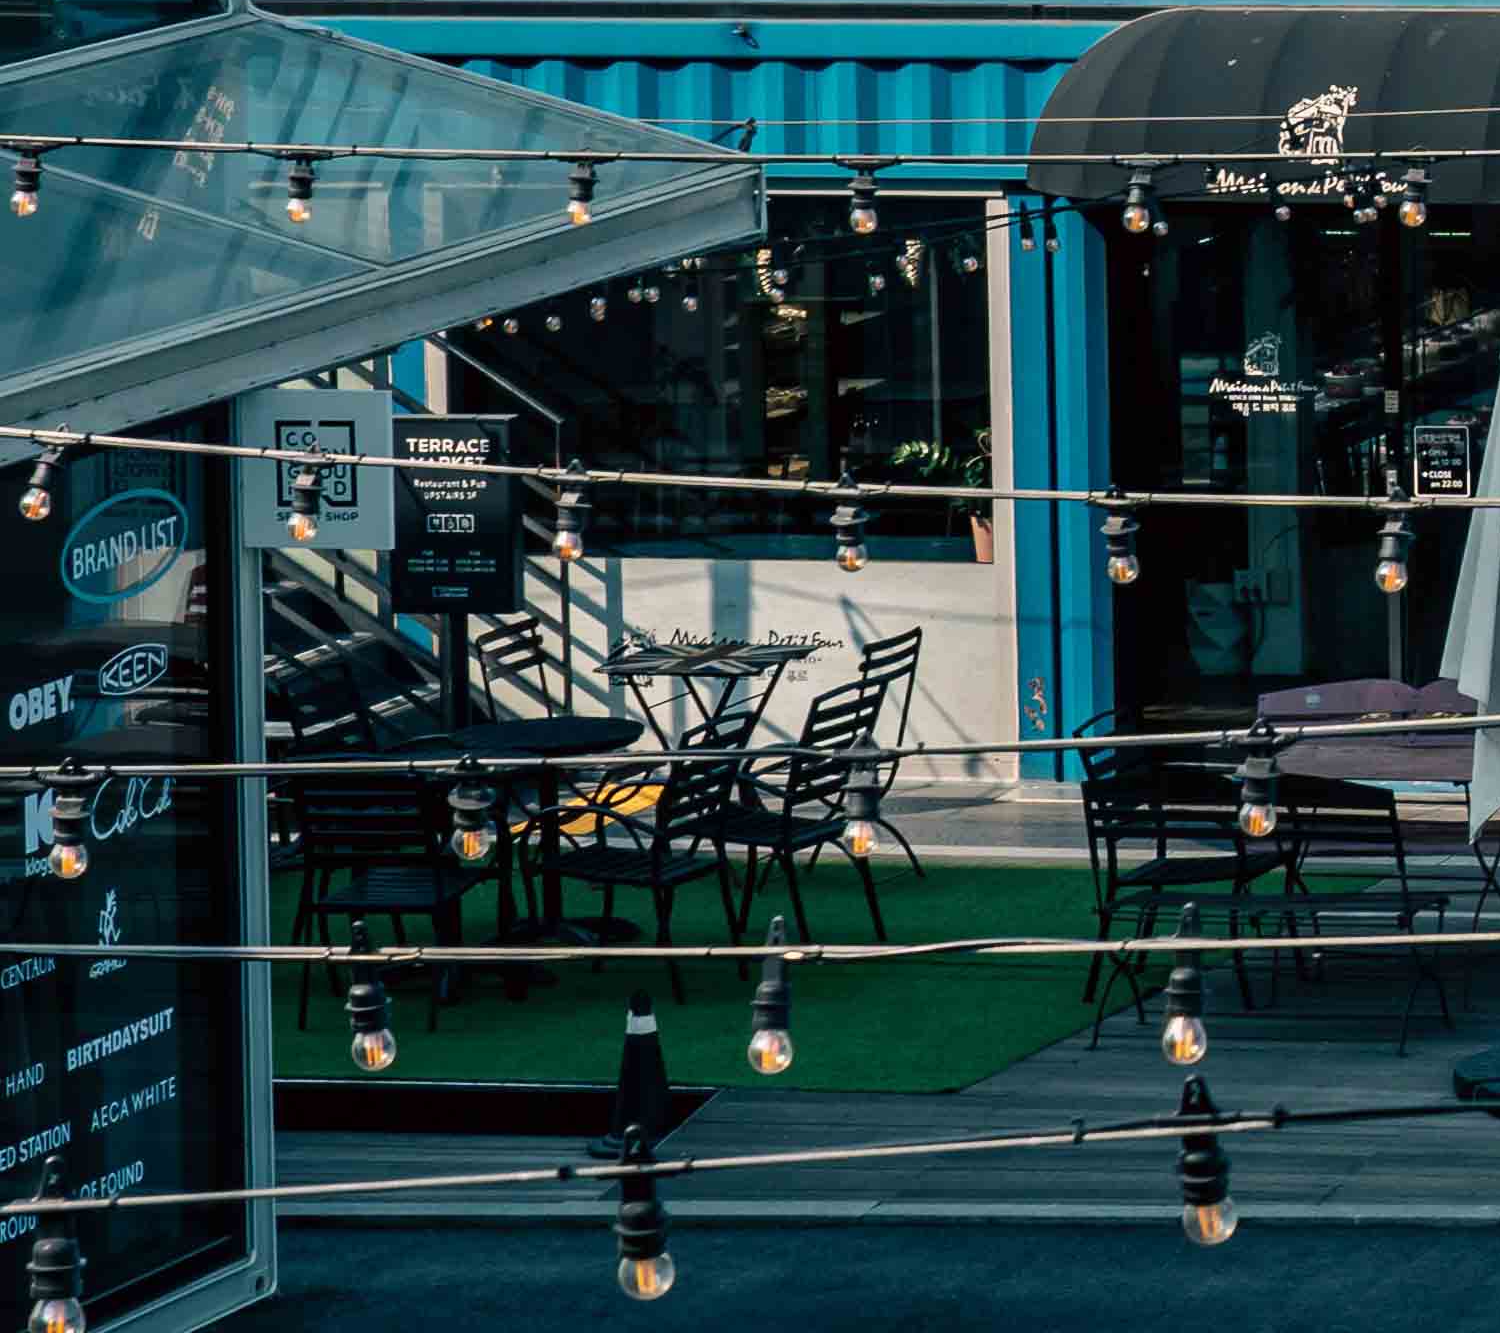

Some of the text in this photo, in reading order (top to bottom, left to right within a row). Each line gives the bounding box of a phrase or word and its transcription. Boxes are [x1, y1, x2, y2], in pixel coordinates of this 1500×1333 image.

[1206, 168, 1306, 196] Maion
[1209, 378, 1264, 393] Maison
[405, 437, 491, 454] TERRACE
[413, 478, 460, 489] Restaurant
[1429, 470, 1452, 479] CLOSE
[424, 491, 465, 501] UPSTAIRS
[325, 511, 359, 522] SHOP
[72, 515, 178, 580] BRAND LIST
[102, 650, 166, 690] KEEN
[9, 674, 75, 731] OBEY.
[0, 955, 56, 991] CENTAUR
[66, 1006, 175, 1072] BIRTHDAYSUIT
[5, 1062, 46, 1098] HAND
[91, 1075, 177, 1133] AECA WHITE
[18, 1122, 72, 1161] STATION
[99, 1159, 145, 1196] FOUND
